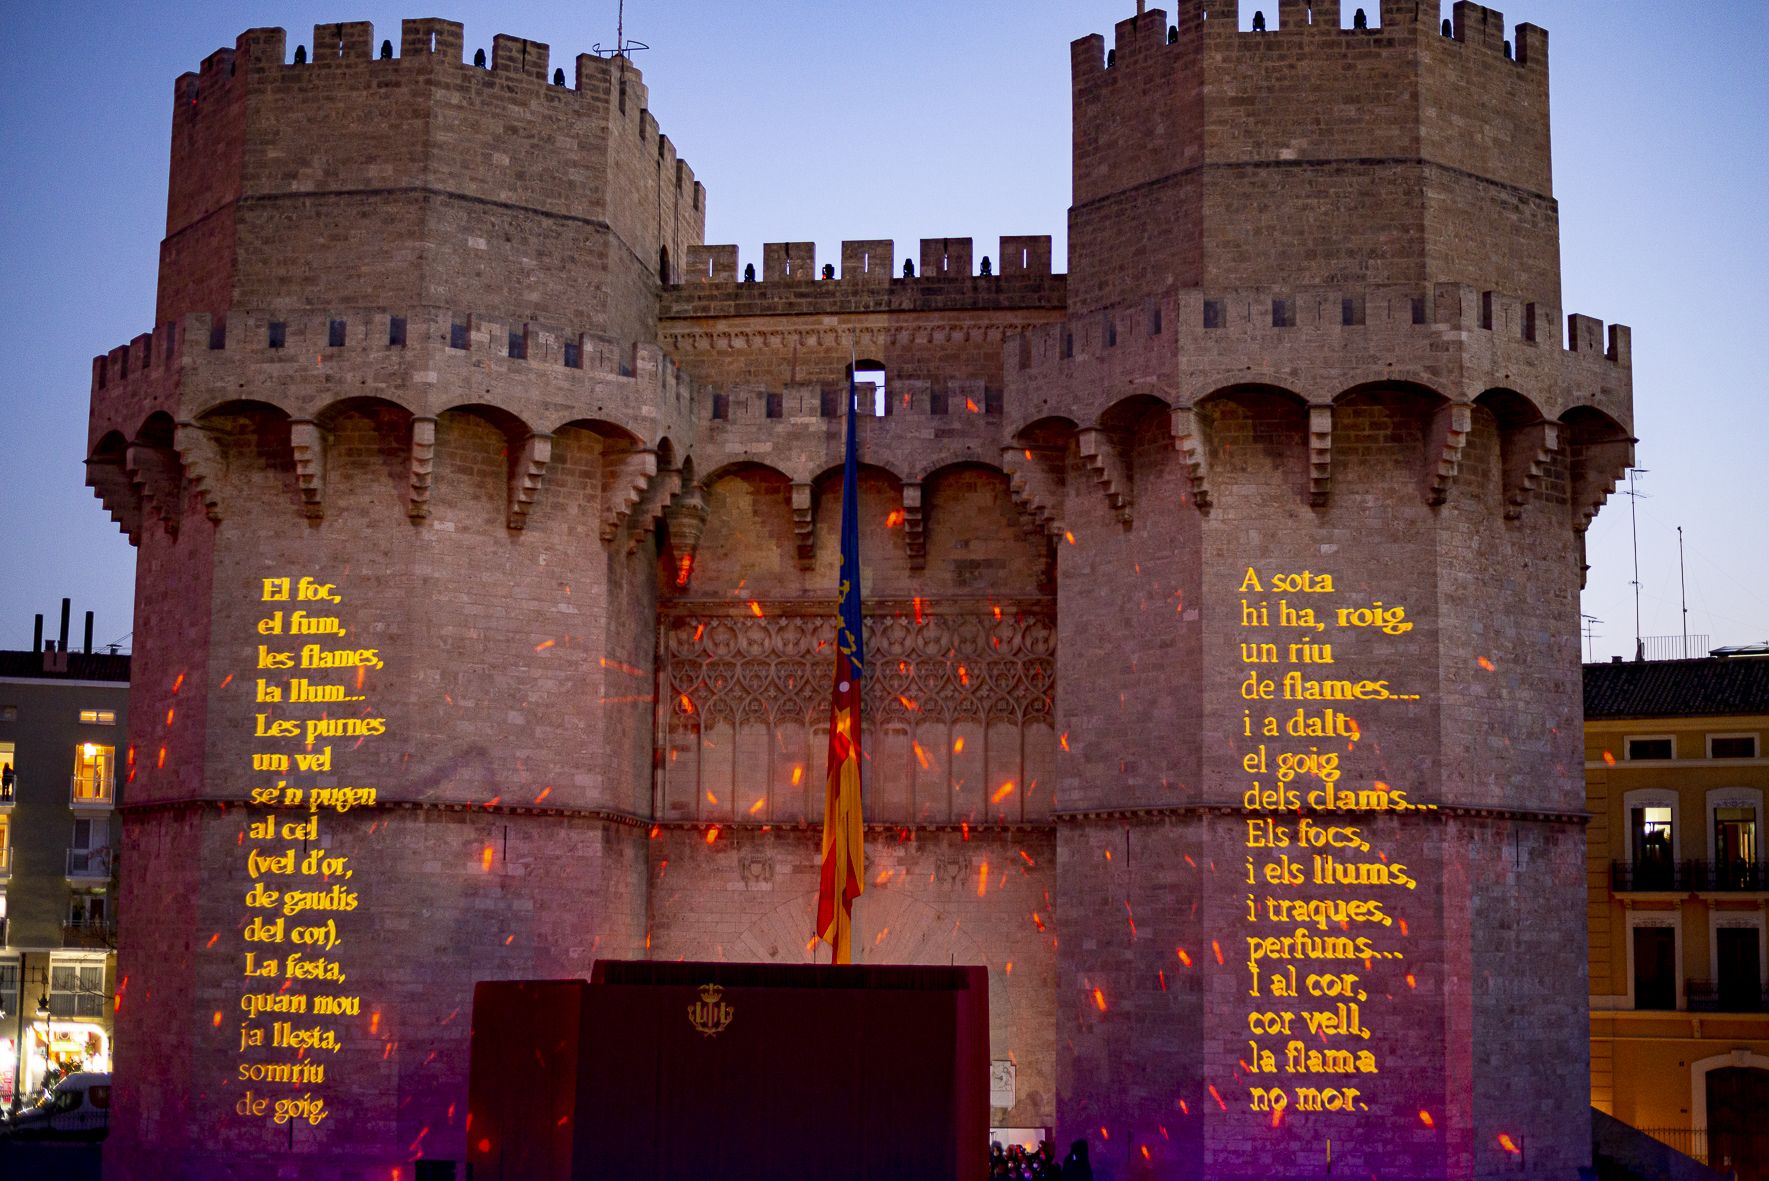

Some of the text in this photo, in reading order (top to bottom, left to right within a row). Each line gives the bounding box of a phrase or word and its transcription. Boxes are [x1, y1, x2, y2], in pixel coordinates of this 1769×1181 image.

[261, 577, 342, 604] El foc,
[1238, 566, 1335, 592] A sota
[257, 610, 347, 637] el fum,
[1241, 600, 1269, 627] hi
[1279, 600, 1325, 632] ha,
[257, 644, 385, 670] les flames,
[1241, 637, 1335, 664] un riu
[256, 678, 366, 703] la llum...
[1241, 671, 1421, 700] de flames...
[254, 713, 386, 744] Les purnes
[1243, 708, 1361, 742] i a dalt,
[252, 746, 332, 772] un vel
[1243, 744, 1342, 782] el goig
[308, 786, 377, 813] pugen
[1243, 781, 1438, 811] dels clams...
[250, 815, 319, 842] al cel
[1246, 817, 1371, 853] Els focs,
[248, 849, 296, 879] (vel
[1246, 853, 1417, 890] i els llums,
[245, 883, 359, 916] de gaudis
[1246, 893, 1393, 930] i traques,
[244, 917, 342, 951] del cor).
[1246, 927, 1404, 967] perfums...
[244, 952, 347, 985] La festa,
[1249, 964, 1368, 1002] I al cor,
[241, 993, 361, 1018] quan mou
[1248, 1002, 1371, 1040] cor vell,
[239, 1021, 342, 1054] ja llesta,
[238, 1057, 326, 1084] somriu
[1248, 1040, 1379, 1073] la flama
[236, 1091, 269, 1117] de
[1248, 1086, 1370, 1112] no mor.
